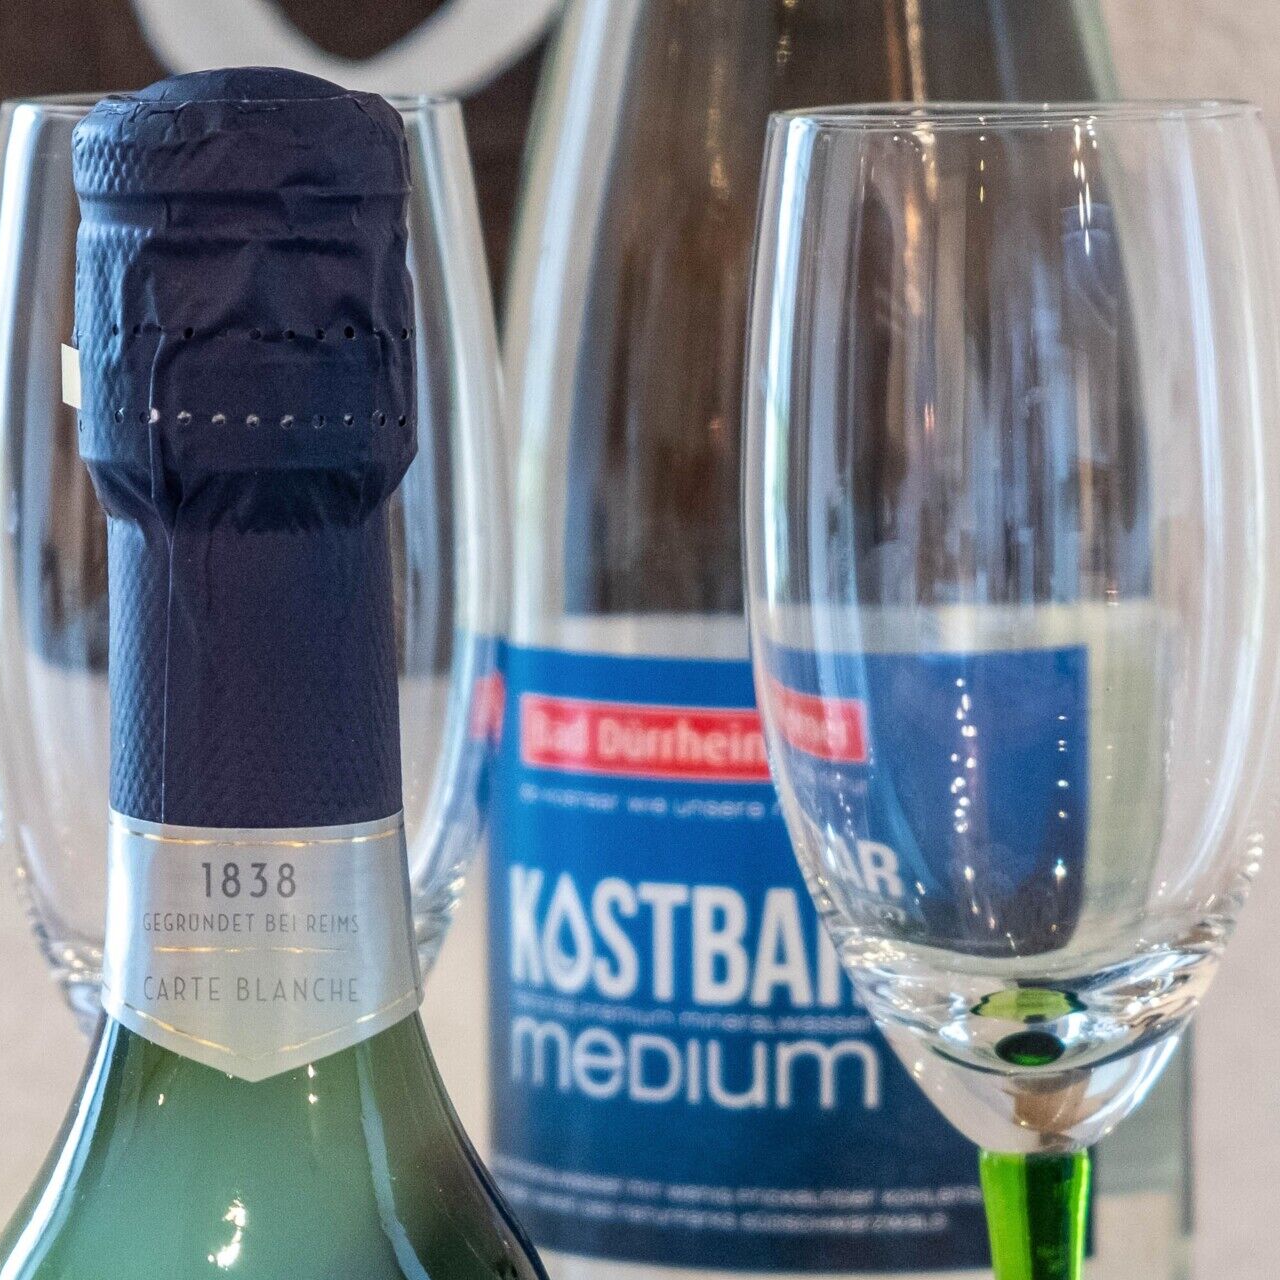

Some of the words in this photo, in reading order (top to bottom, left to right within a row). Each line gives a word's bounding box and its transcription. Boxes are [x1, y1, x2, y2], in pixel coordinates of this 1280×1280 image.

[596, 715, 766, 767] Dürrheim
[201, 862, 296, 898] 1838
[142, 912, 253, 932] GEGRÜNDET
[265, 912, 296, 932] BEI
[306, 914, 360, 933] REIMS
[143, 976, 220, 1001] CARTE
[237, 977, 359, 1002] BLANCHE
